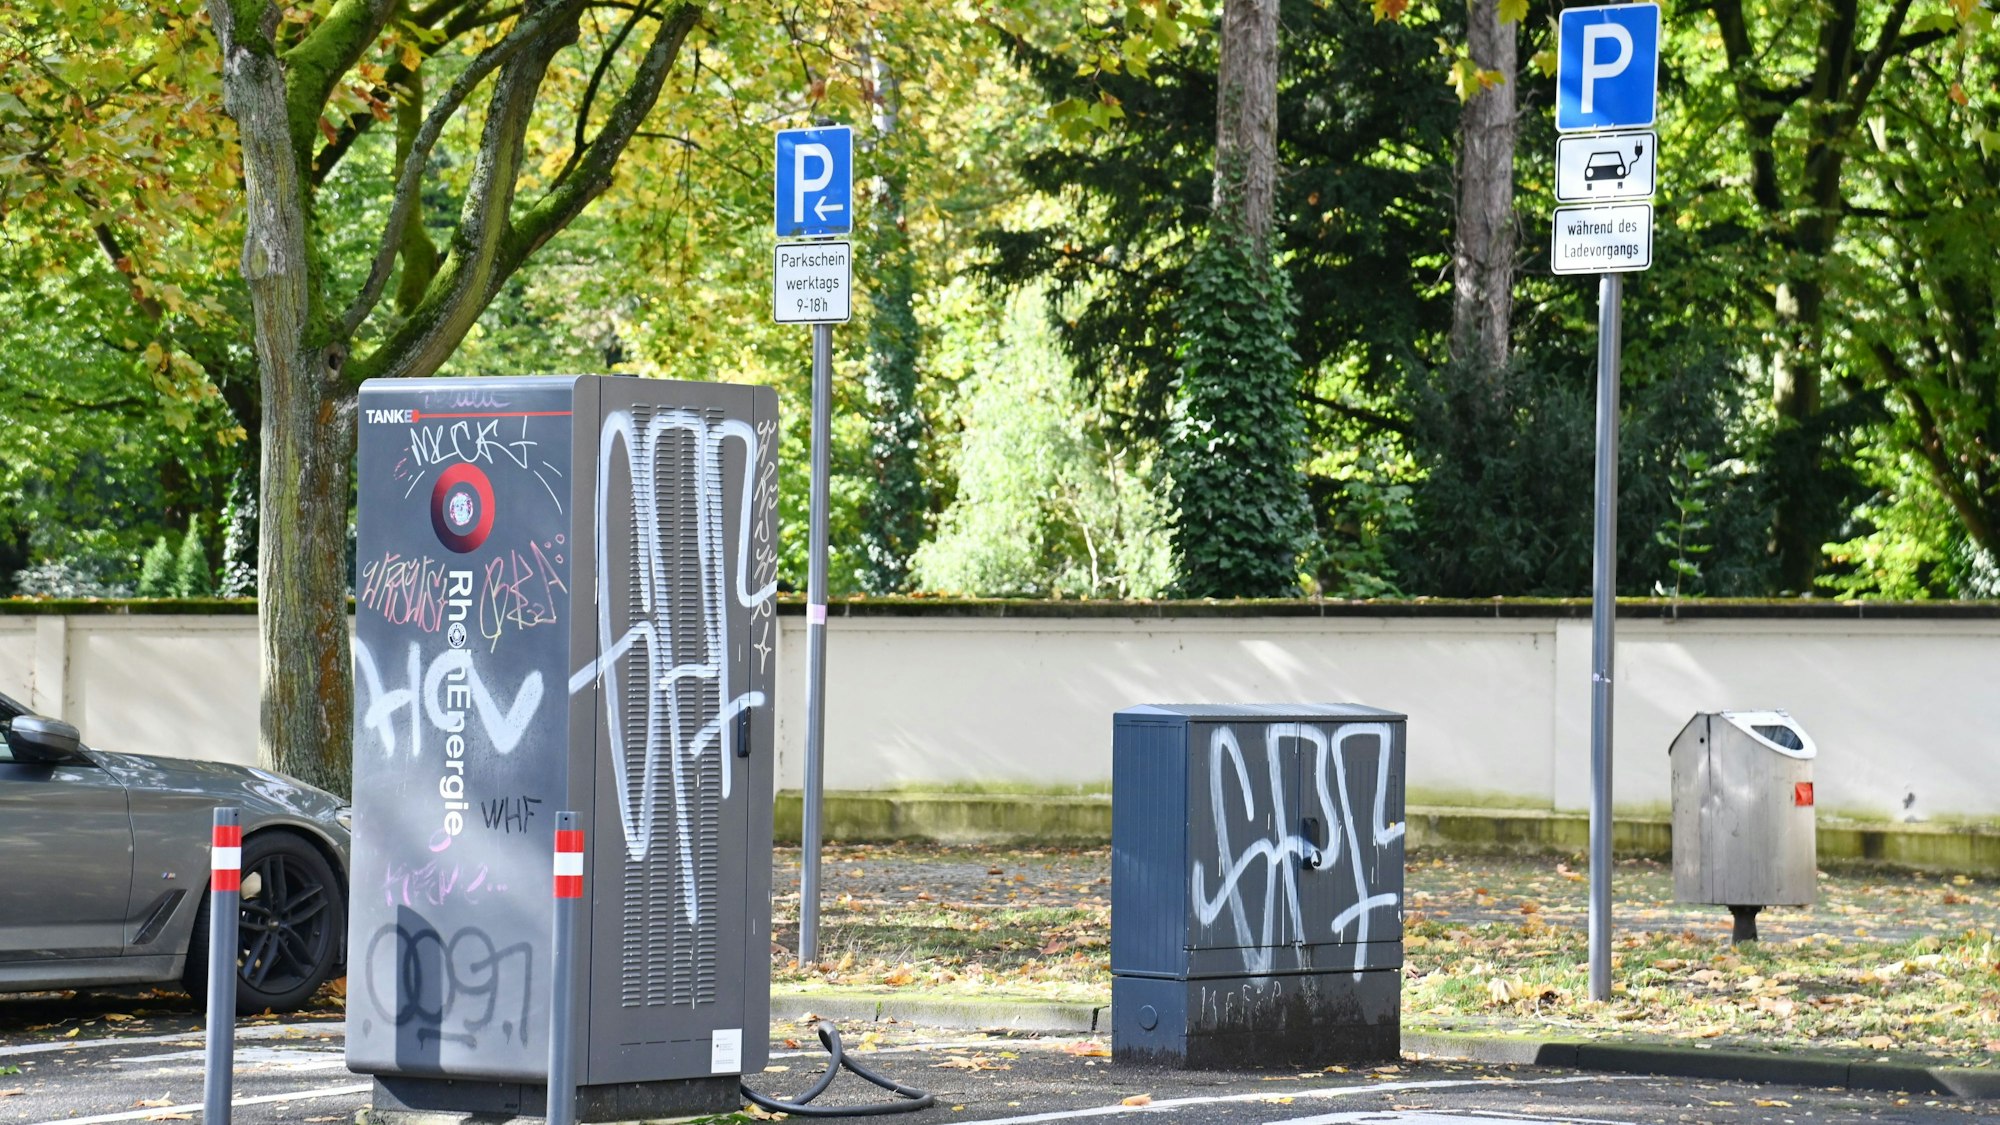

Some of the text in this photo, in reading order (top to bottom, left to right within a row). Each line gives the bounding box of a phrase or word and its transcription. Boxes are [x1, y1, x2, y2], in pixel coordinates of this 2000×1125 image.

[1581, 23, 1634, 114] P
[794, 143, 834, 223] P
[1567, 217, 1637, 236] während des
[781, 251, 845, 268] Parkschein
[1564, 242, 1639, 259] Ladevorgangs
[786, 275, 840, 293] werktags
